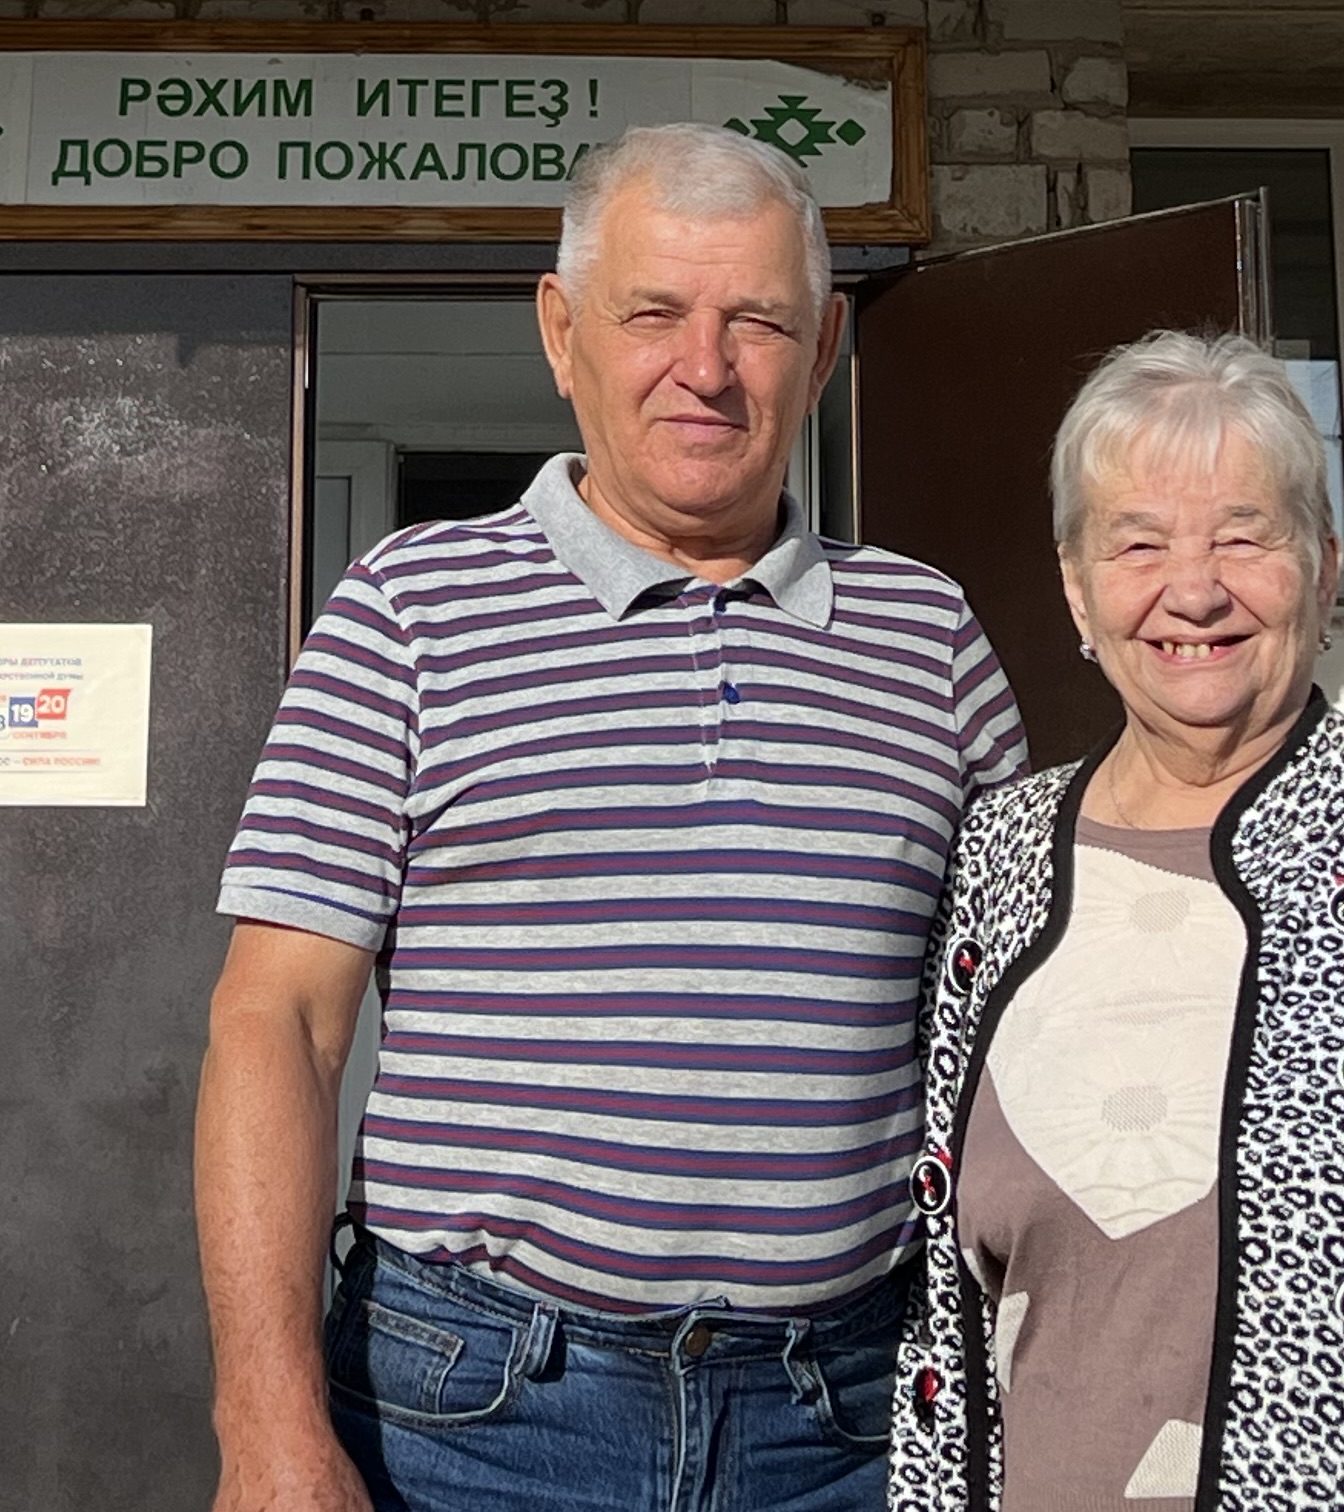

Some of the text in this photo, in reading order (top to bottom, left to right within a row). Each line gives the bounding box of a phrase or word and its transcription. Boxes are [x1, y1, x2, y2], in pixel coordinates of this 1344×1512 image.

[118, 77, 313, 117] РӘХИМ
[51, 138, 590, 186] ДОБРО ПОЖАЛОВ
[10, 703, 34, 723] 19
[37, 694, 65, 714] 20
